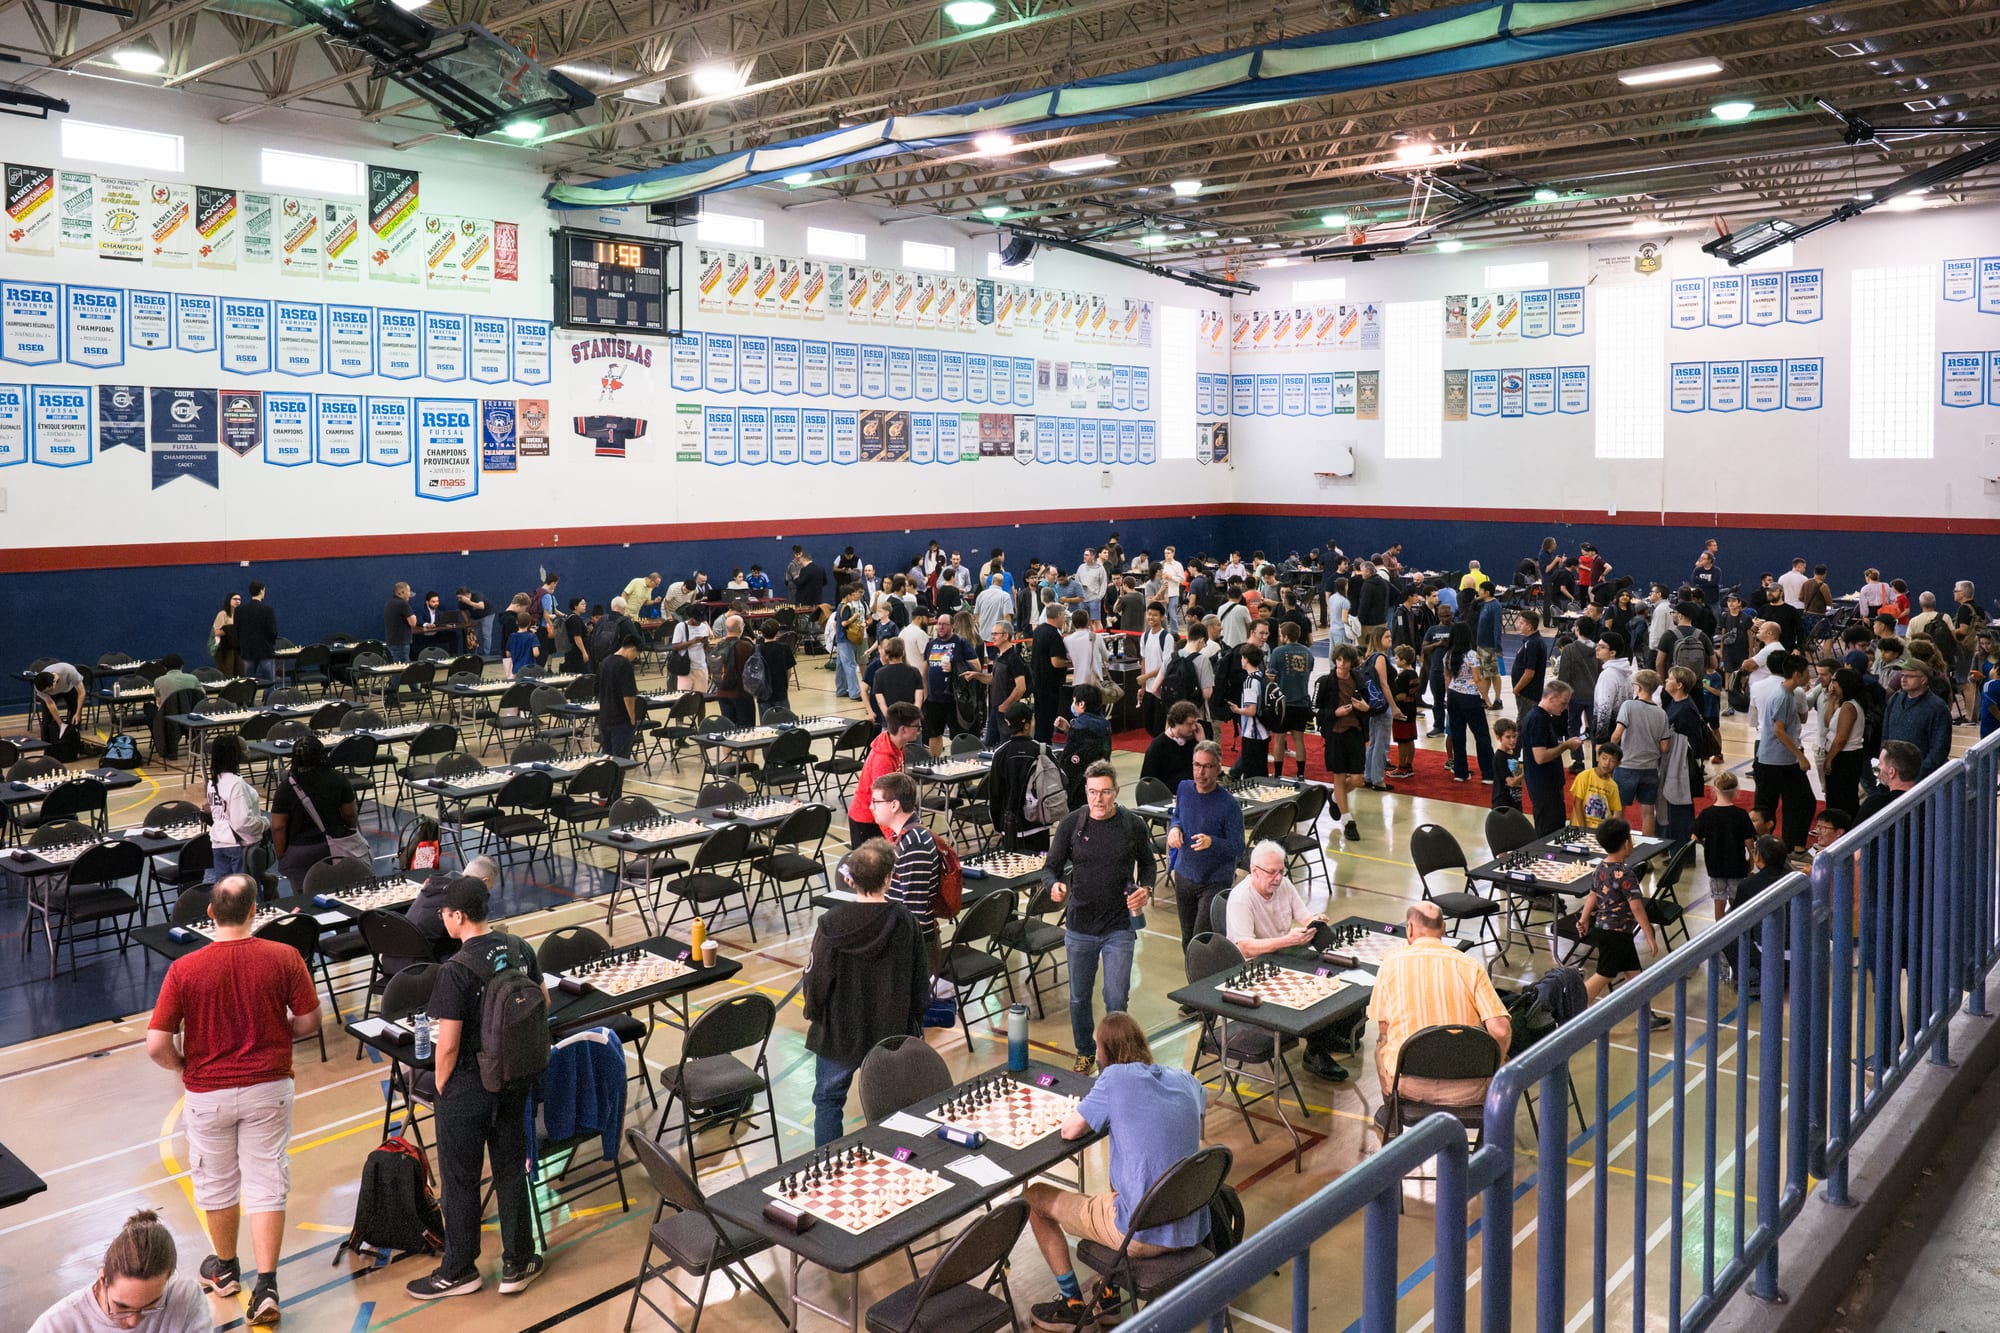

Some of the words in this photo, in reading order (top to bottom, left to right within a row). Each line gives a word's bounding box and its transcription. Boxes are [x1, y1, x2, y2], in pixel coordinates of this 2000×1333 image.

[10, 173, 48, 203] BASKET-BALL
[10, 184, 49, 215] CHAMPIONNES
[201, 193, 232, 221] SOCCER
[152, 200, 185, 229] BASKET-BALL
[200, 204, 233, 233] CHAMPIONS
[153, 209, 186, 240] CHAMPIONS
[325, 213, 355, 242] BASKET-BALL
[102, 243, 142, 251] CHAMPION
[598, 242, 641, 267] 11:58
[1751, 278, 1778, 286] RSEQ
[1790, 275, 1819, 283] RSEQ
[1675, 283, 1700, 292] RSEQ
[1713, 281, 1739, 289] RSEQ
[6, 288, 53, 303] RSEQ
[73, 293, 117, 307] RSEQ
[134, 295, 166, 305] RSEQ
[1557, 292, 1581, 300] RSEQ
[7, 301, 53, 309] BADMINTON
[180, 299, 211, 308] RSEQ
[226, 305, 264, 317] RSEQ
[280, 308, 317, 320] RSEQ
[332, 312, 368, 323] RSEQ
[383, 315, 416, 326] RSEQ
[76, 324, 114, 333] CHAMPIONS
[429, 318, 461, 330] RSEQ
[474, 322, 504, 333] RSEQ
[517, 325, 546, 336] RSEQ
[675, 337, 699, 346] RSEQ
[709, 338, 732, 348] RSEQ
[743, 341, 765, 350] RSEQ
[775, 343, 796, 352] RSEQ
[571, 338, 653, 368] STANISLAS
[1948, 358, 1980, 367] RSEQ
[1713, 367, 1739, 375] RSEQ
[1790, 364, 1818, 372] RSEQ
[1562, 371, 1585, 379] RSEQ
[39, 395, 85, 407] RSEQ
[269, 401, 307, 412] RSEQ
[322, 402, 357, 413] RSEQ
[372, 404, 406, 415] RSEQ
[422, 413, 470, 427] RSEQ
[709, 414, 732, 422] RSEQ
[742, 414, 764, 423] RSEQ
[774, 415, 796, 423] RSEQ
[805, 416, 826, 424] RSEQ
[38, 422, 60, 430] ÉTHIQUE
[427, 448, 467, 457] CHAMPIONS
[423, 457, 470, 466] PROVINCIAUX
[440, 479, 466, 487] mass
[1040, 1077, 1050, 1086] 12
[896, 1150, 907, 1160] 13
